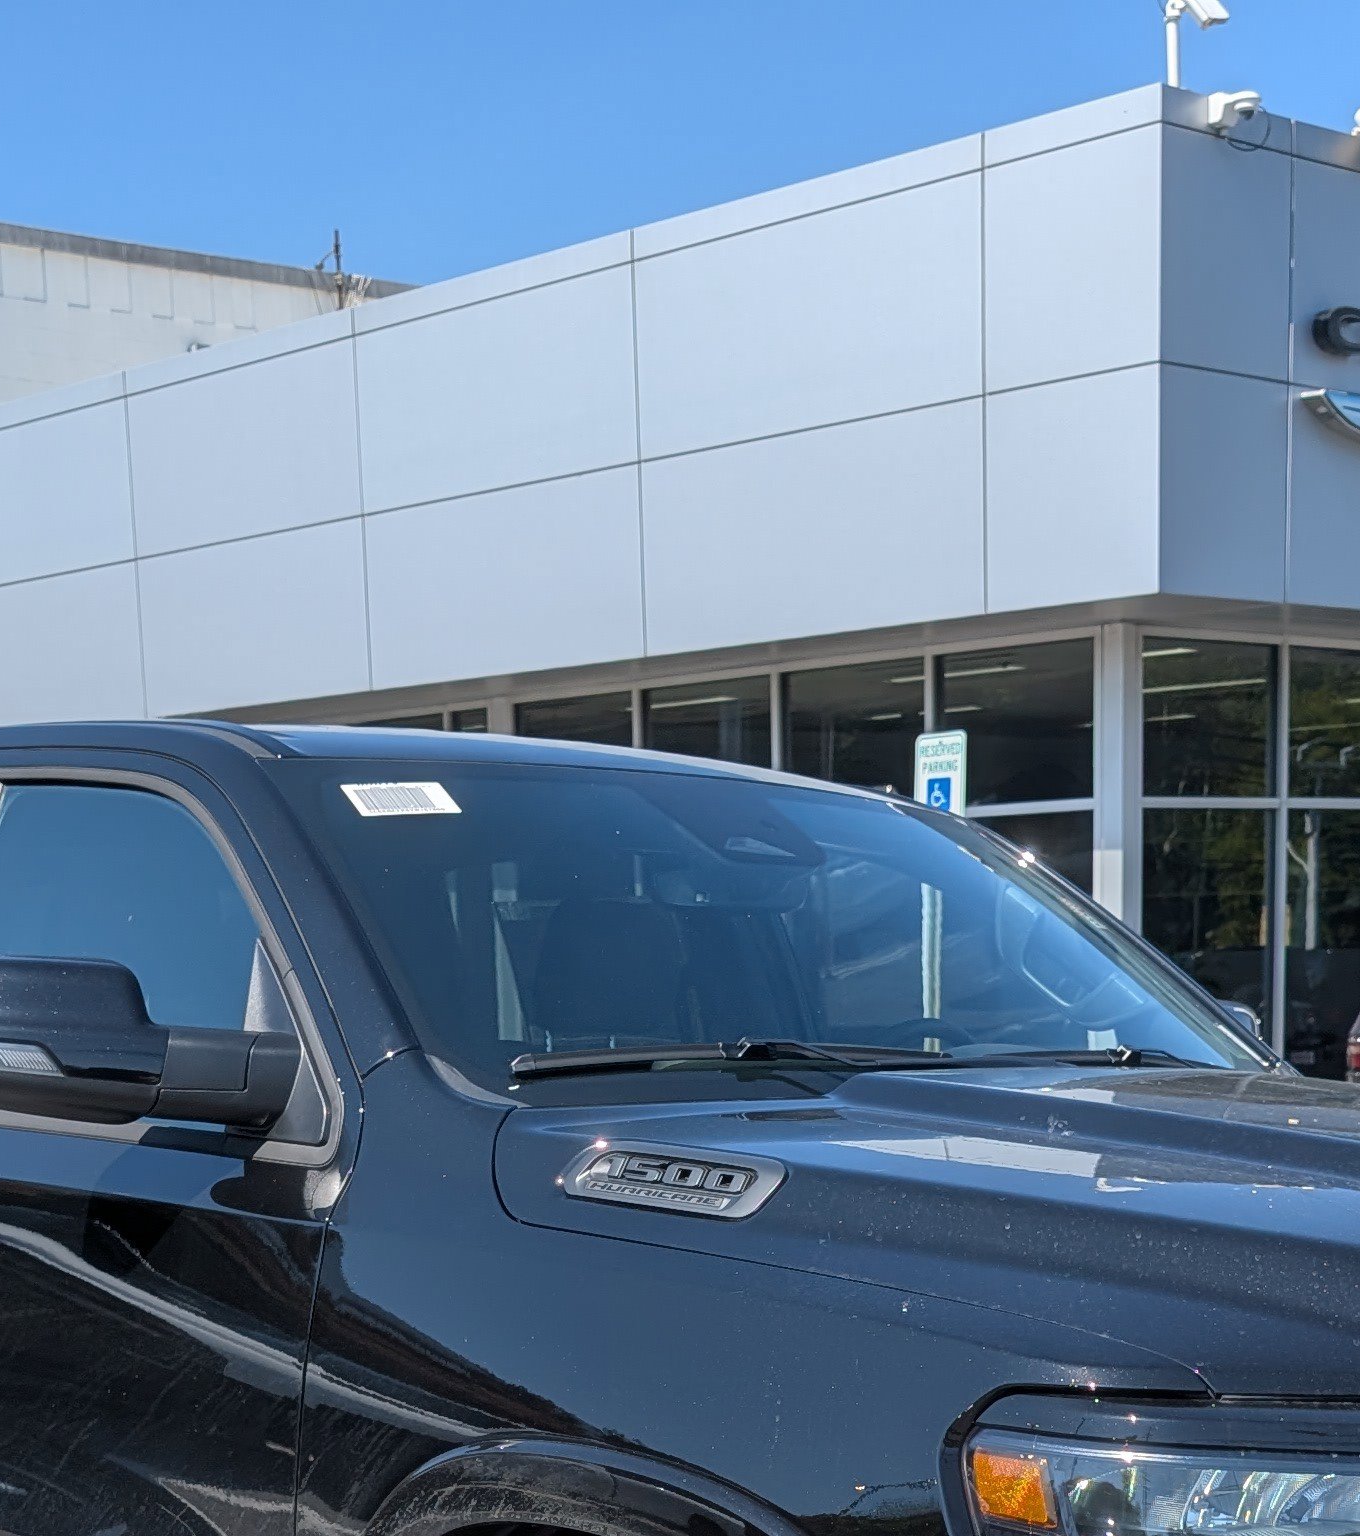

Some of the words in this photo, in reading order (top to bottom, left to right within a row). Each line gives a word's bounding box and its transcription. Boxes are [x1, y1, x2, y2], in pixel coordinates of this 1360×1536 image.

[920, 743, 961, 757] RESERVED
[923, 760, 958, 773] PARKING
[589, 1153, 753, 1194] 1500
[591, 1182, 720, 1205] HURRICANE
